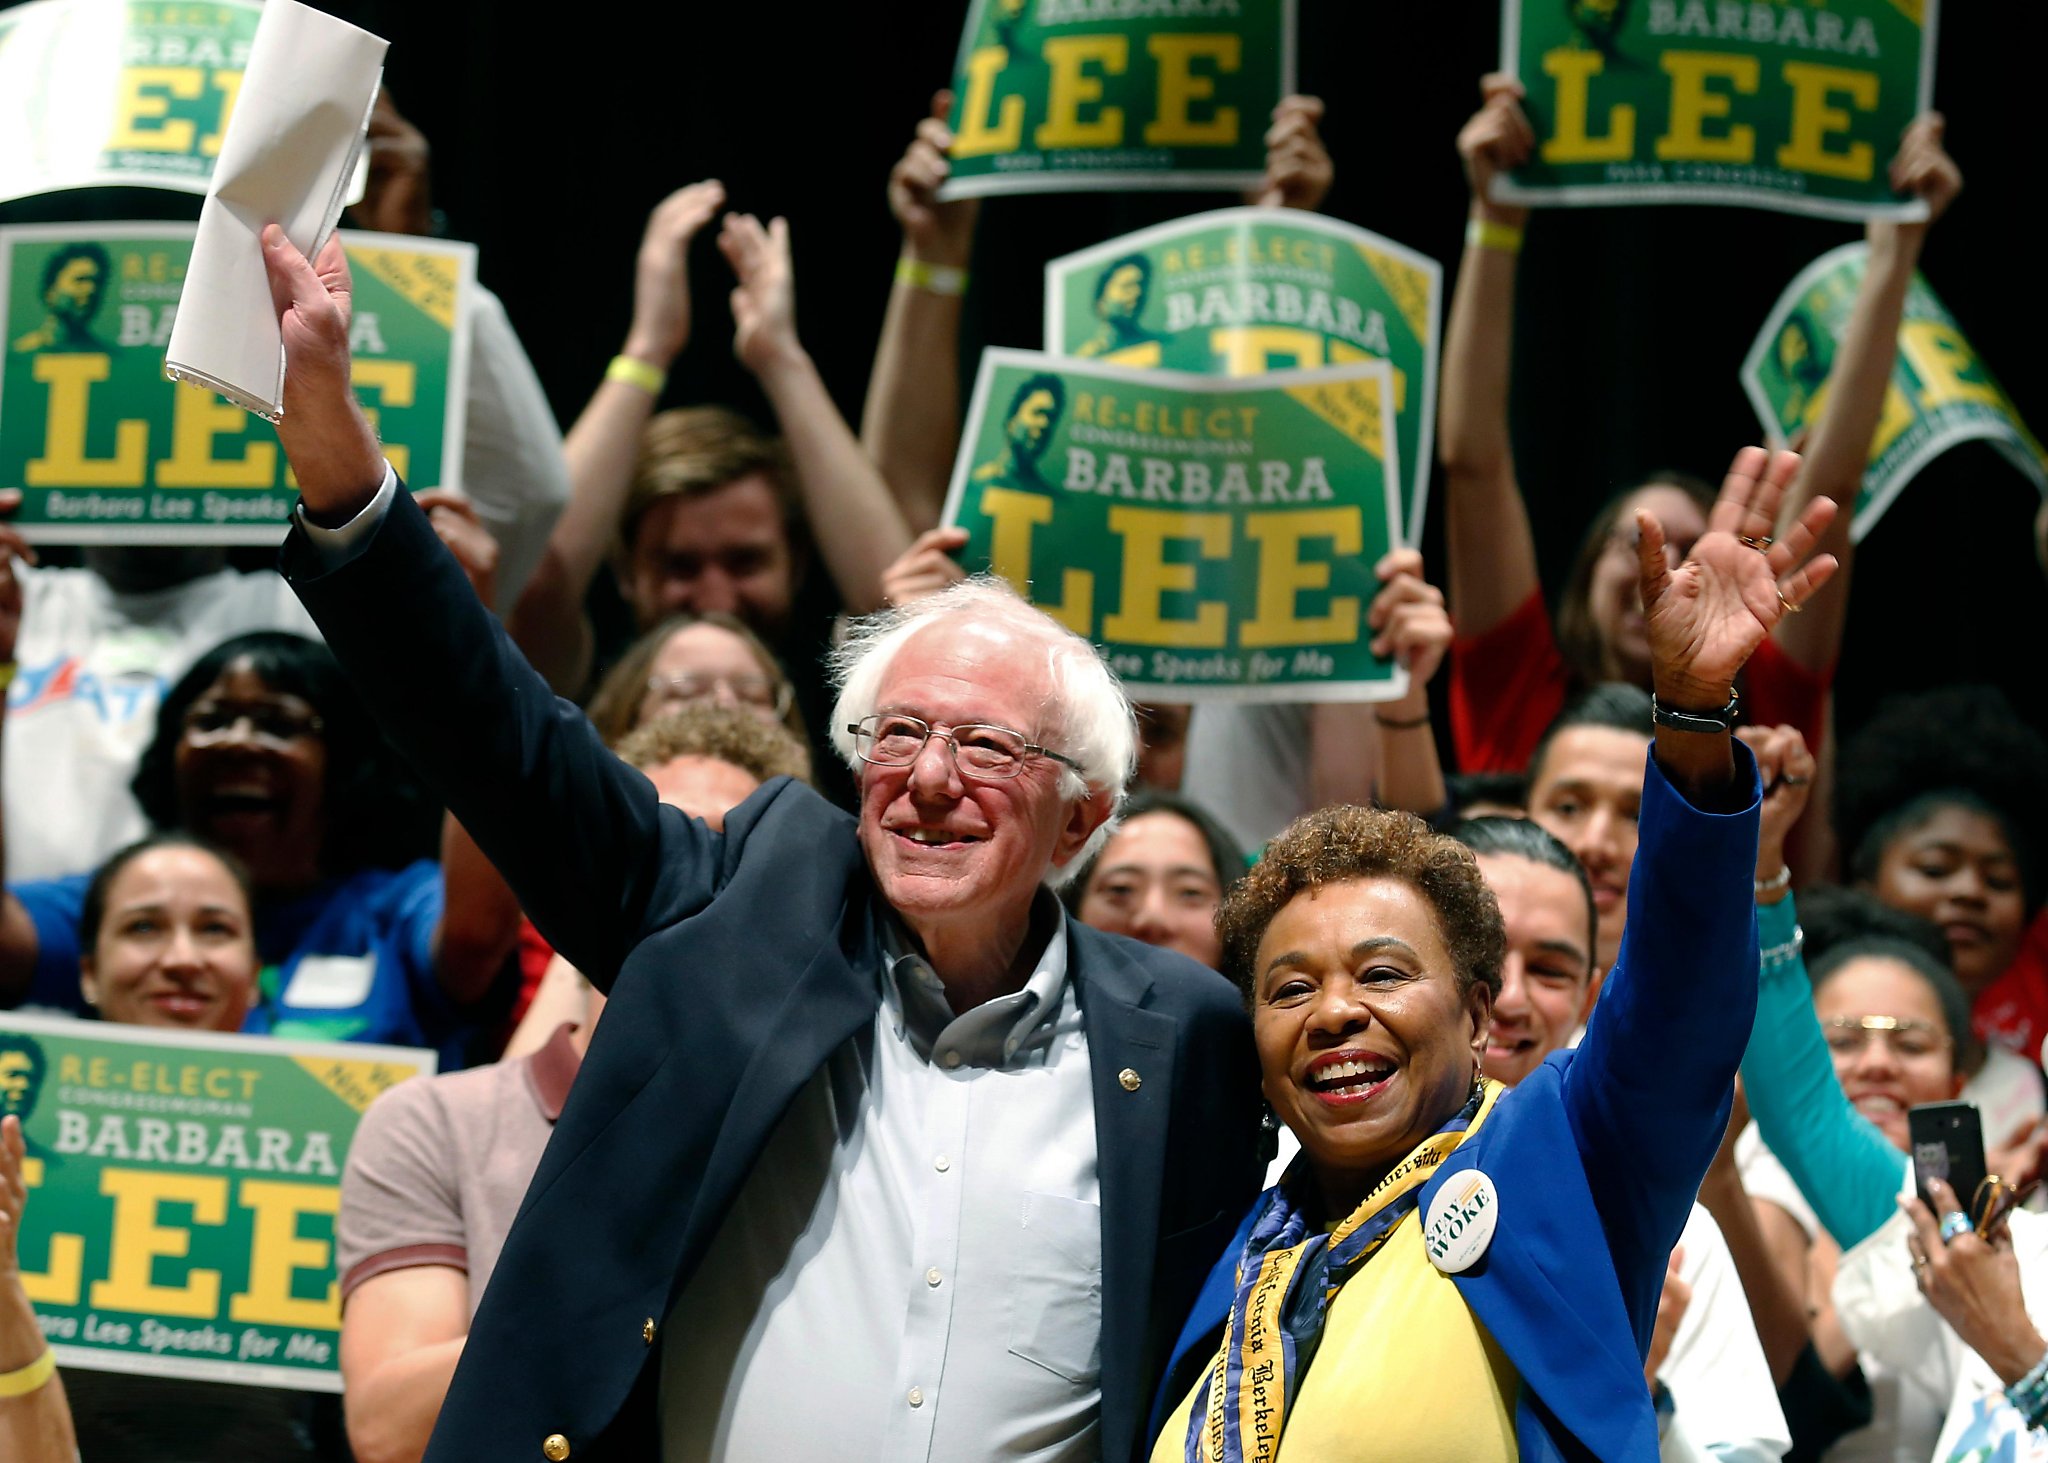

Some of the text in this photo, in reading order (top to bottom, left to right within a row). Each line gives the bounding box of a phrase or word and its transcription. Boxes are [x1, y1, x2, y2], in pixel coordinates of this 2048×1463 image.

[1645, 0, 1880, 57] BARBARA
[948, 33, 1243, 160] LEE
[1541, 48, 1880, 182] LEE
[1163, 236, 1336, 273] RE-ELECT
[1165, 280, 1391, 356] BARBARA
[1072, 392, 1260, 439] RE-ELECT
[1063, 446, 1335, 504] BARBARA
[151, 491, 195, 520] Lee
[202, 490, 289, 525] Speaks
[981, 486, 1362, 650] LEE
[1150, 650, 1241, 682] Speaks
[1247, 650, 1286, 682] for
[1290, 648, 1335, 676] Me
[58, 1053, 264, 1100] RE-ELECT
[55, 1110, 339, 1176] BARBARA
[1344, 1146, 1442, 1224] iversity
[1426, 1198, 1460, 1247] STAY
[1431, 1188, 1491, 1259] WOKE
[1249, 1250, 1293, 1354] California
[83, 1313, 132, 1345] Lee
[139, 1318, 232, 1354] Speaks
[238, 1328, 281, 1361] for
[284, 1332, 331, 1363] Me
